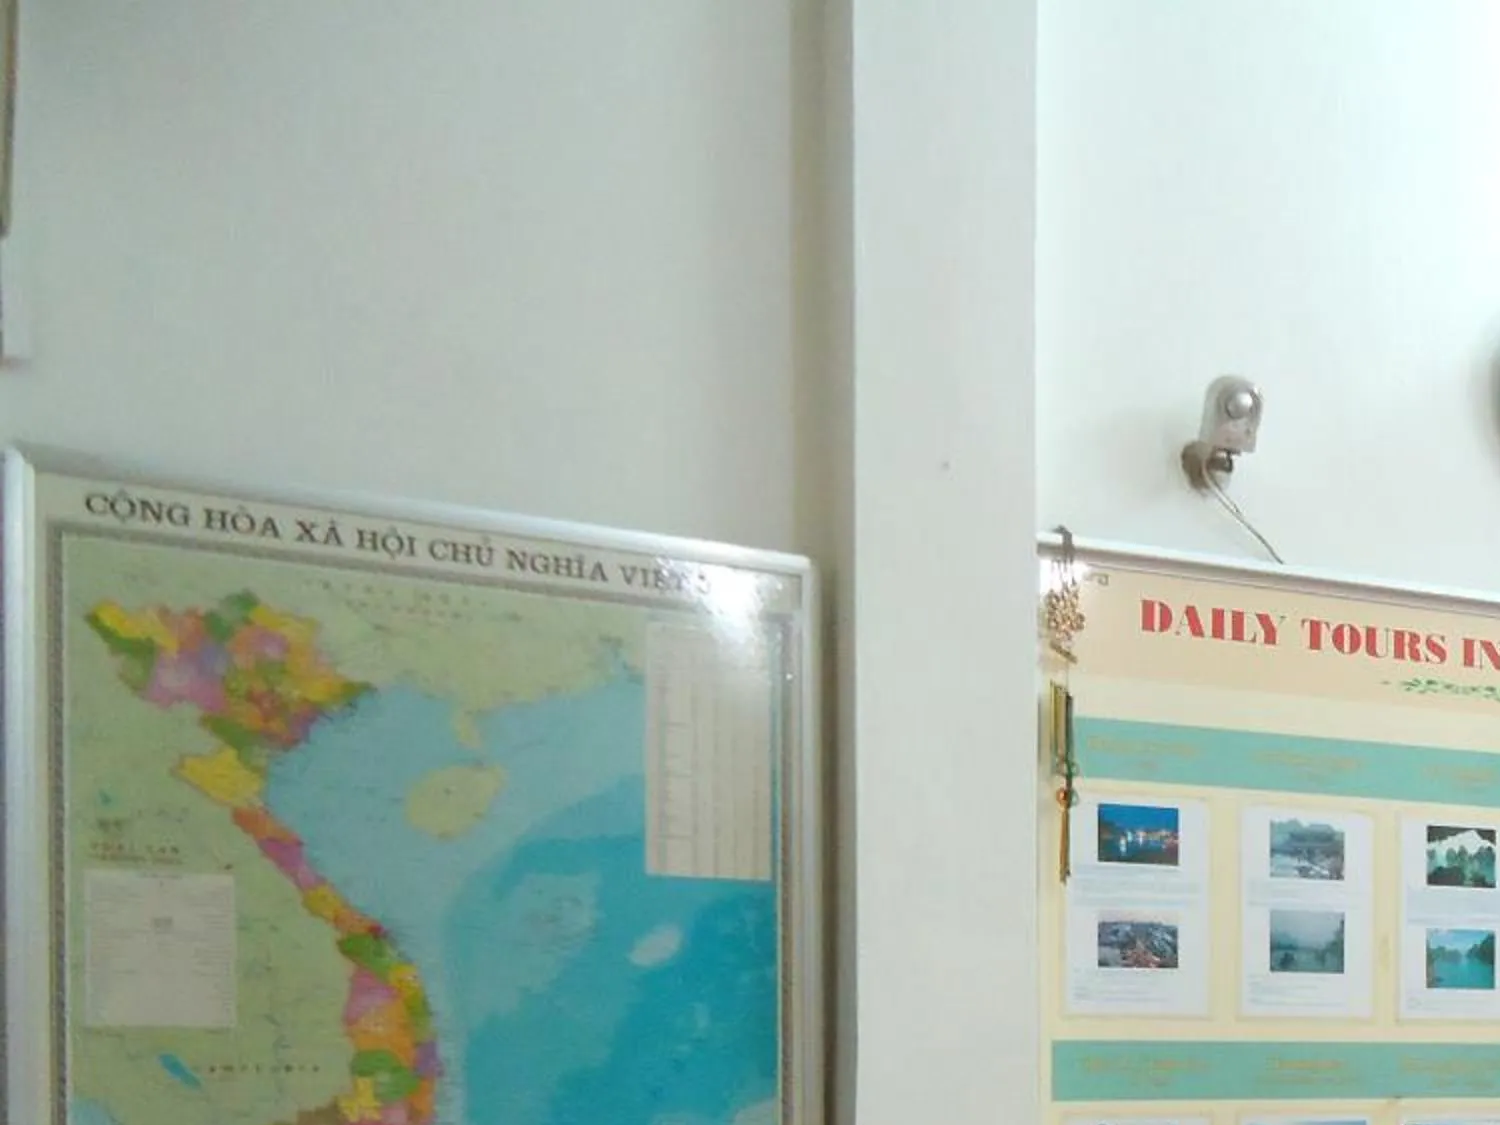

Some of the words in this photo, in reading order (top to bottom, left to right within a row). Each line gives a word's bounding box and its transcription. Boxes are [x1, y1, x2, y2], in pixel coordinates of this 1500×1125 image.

[84, 488, 191, 527] CỘNG
[203, 504, 281, 539] HÒA
[295, 517, 344, 547] XÃ
[356, 524, 418, 560] HỘI
[429, 535, 495, 567] CHỦ
[505, 547, 609, 583] NGHĨA
[1140, 598, 1287, 646] DAILY
[1301, 617, 1448, 665] TOURS
